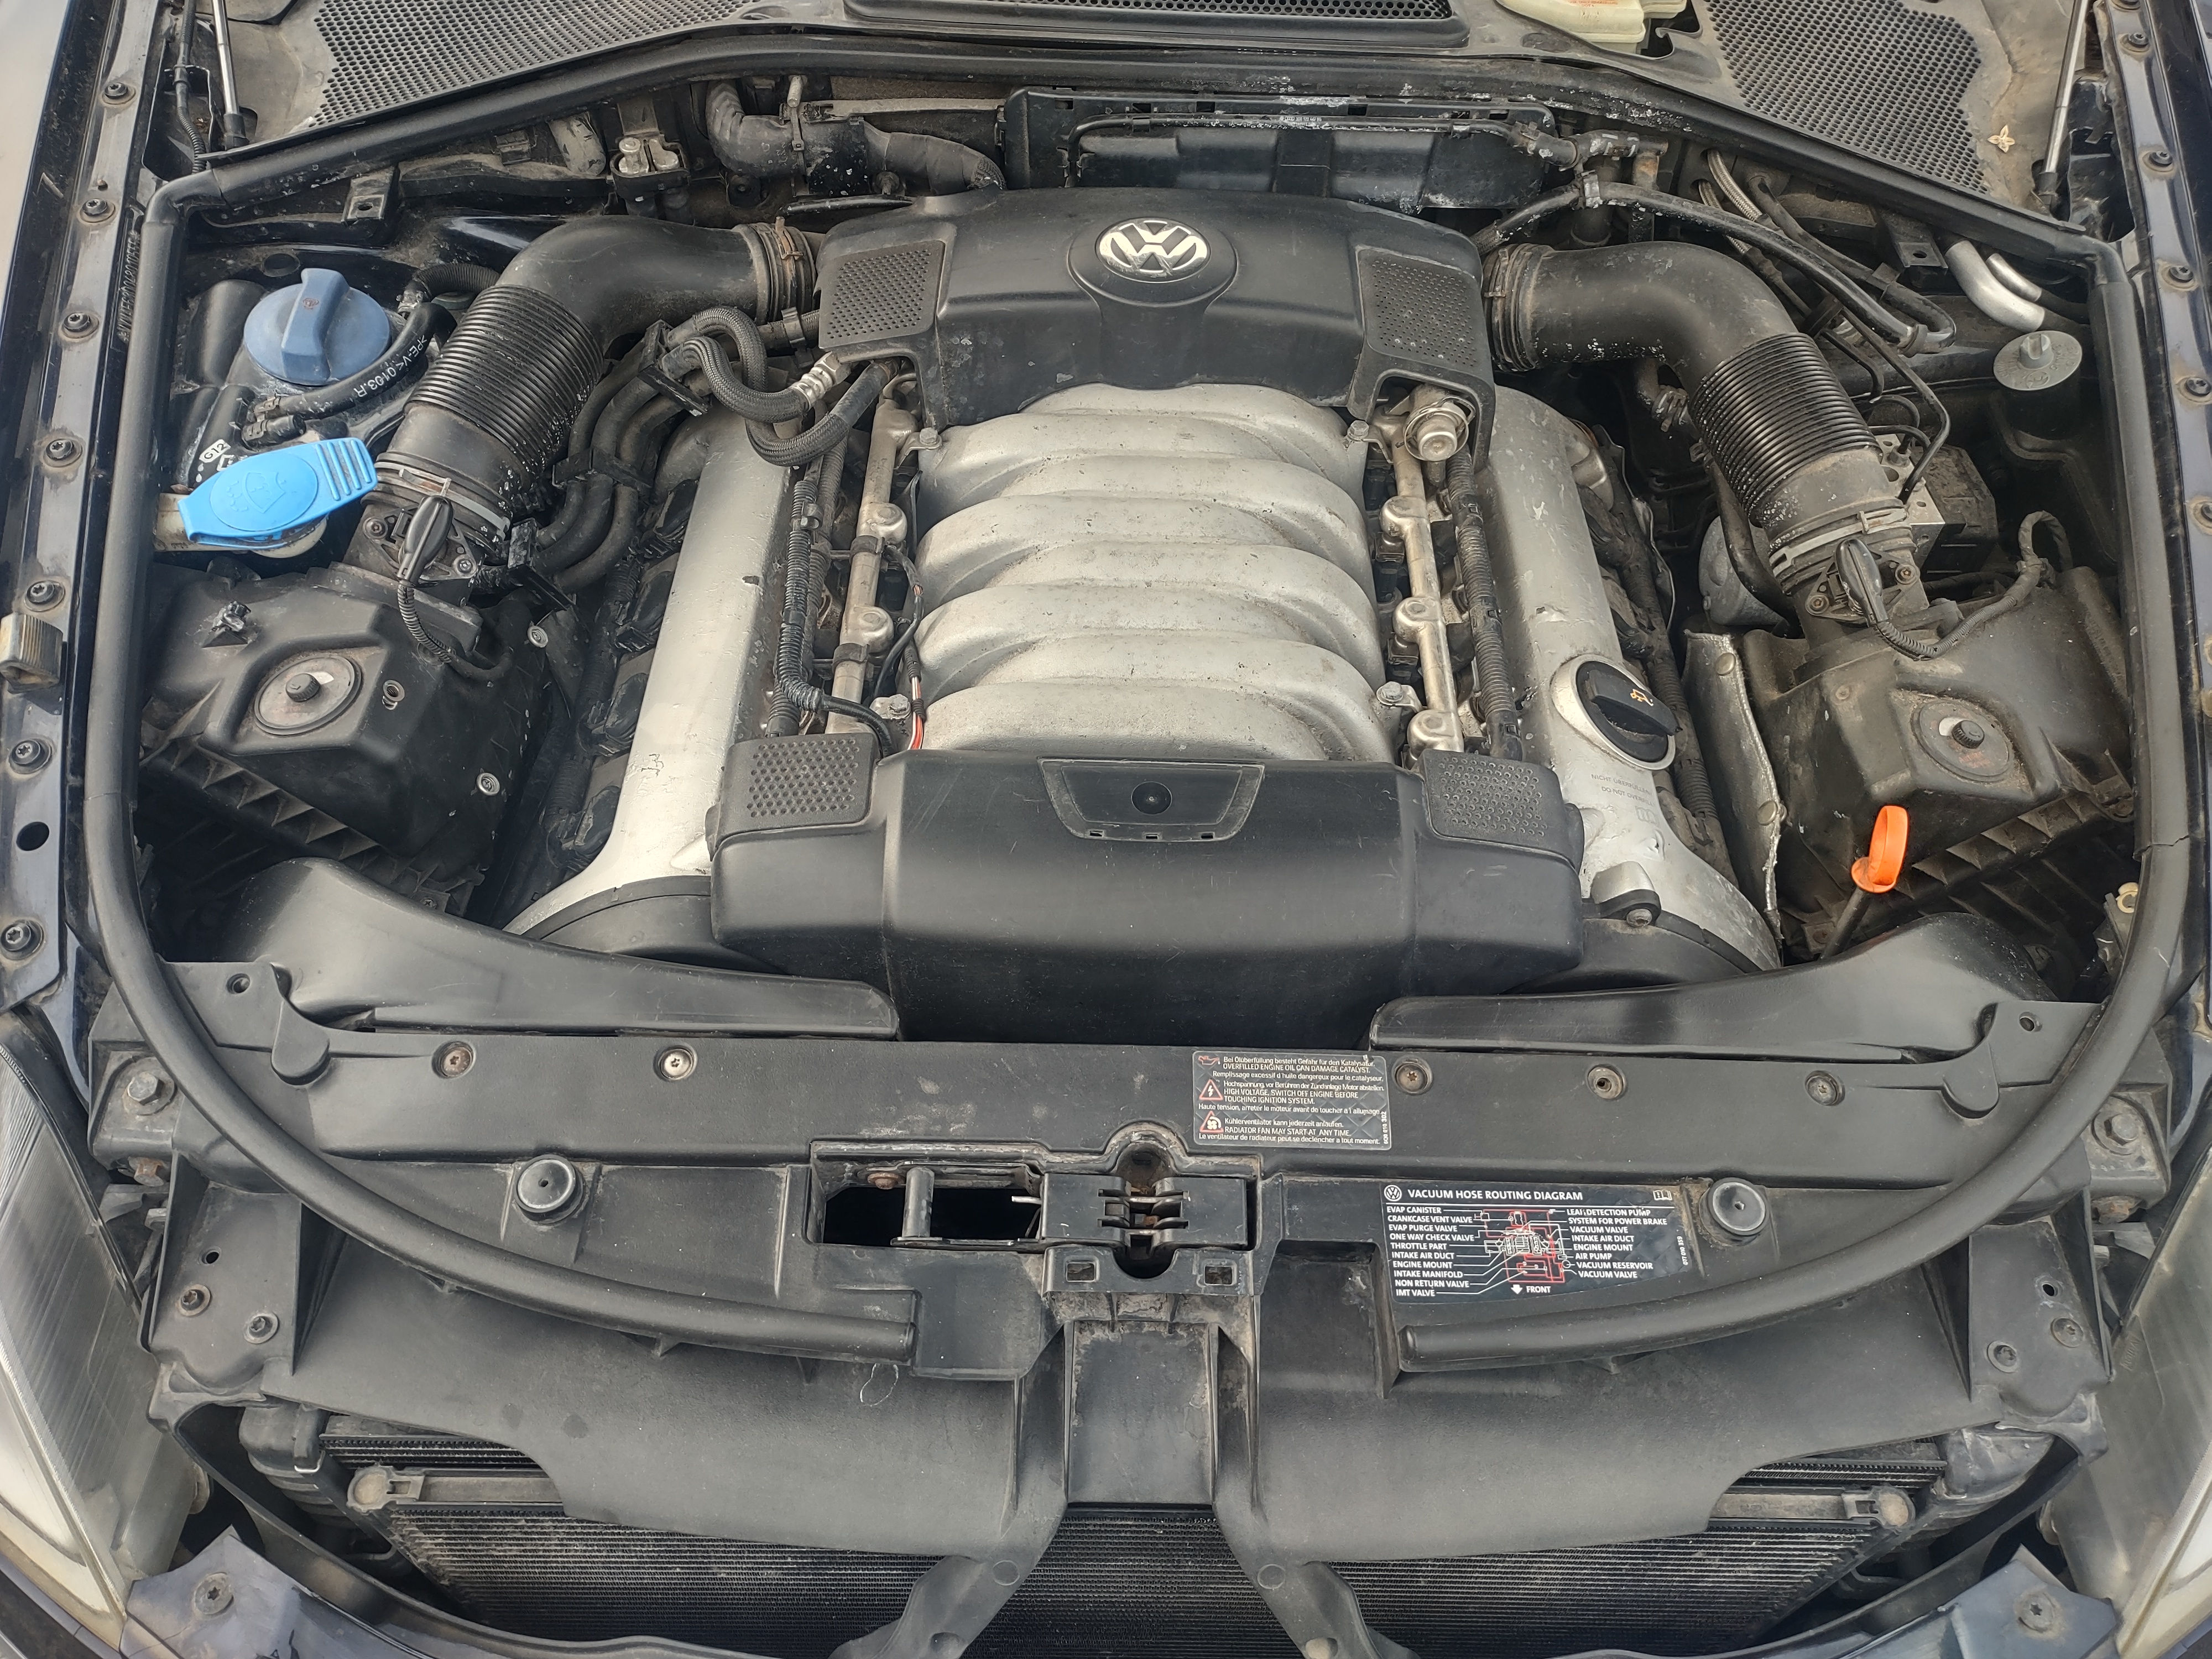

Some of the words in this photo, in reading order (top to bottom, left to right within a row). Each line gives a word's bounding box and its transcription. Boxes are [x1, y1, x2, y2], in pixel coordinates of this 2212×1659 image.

[1096, 217, 1211, 283] VW
[203, 442, 228, 460] G12
[1407, 1189, 1453, 1199] VACUUM
[1455, 1190, 1483, 1199] HOSE
[1485, 1191, 1532, 1199] ROUTING
[1533, 1192, 1583, 1201] DIAGRAM
